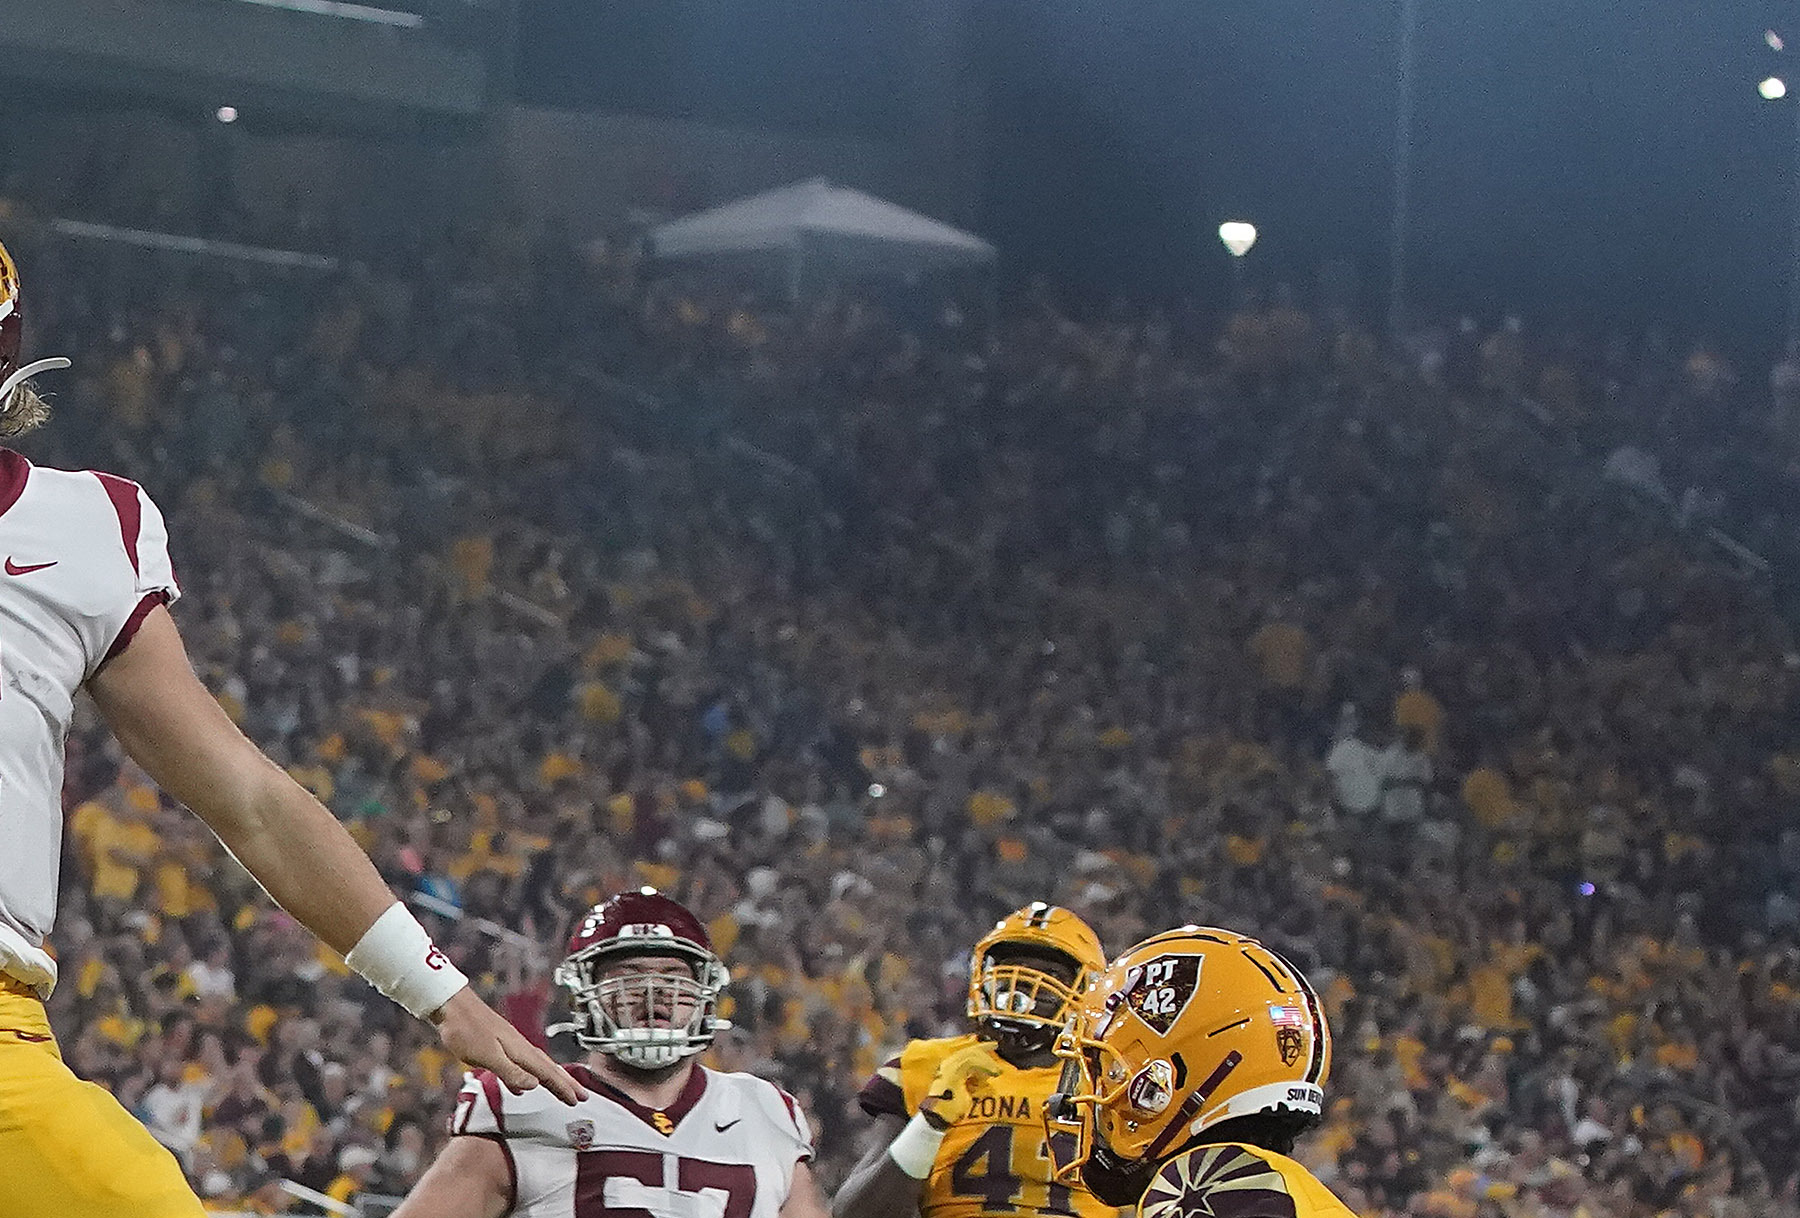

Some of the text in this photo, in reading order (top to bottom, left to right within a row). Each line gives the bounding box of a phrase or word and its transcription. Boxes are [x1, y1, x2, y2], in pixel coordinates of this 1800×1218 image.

[1145, 959, 1179, 986] PT
[1142, 987, 1177, 1015] 42
[1286, 1088, 1307, 1101] SUN
